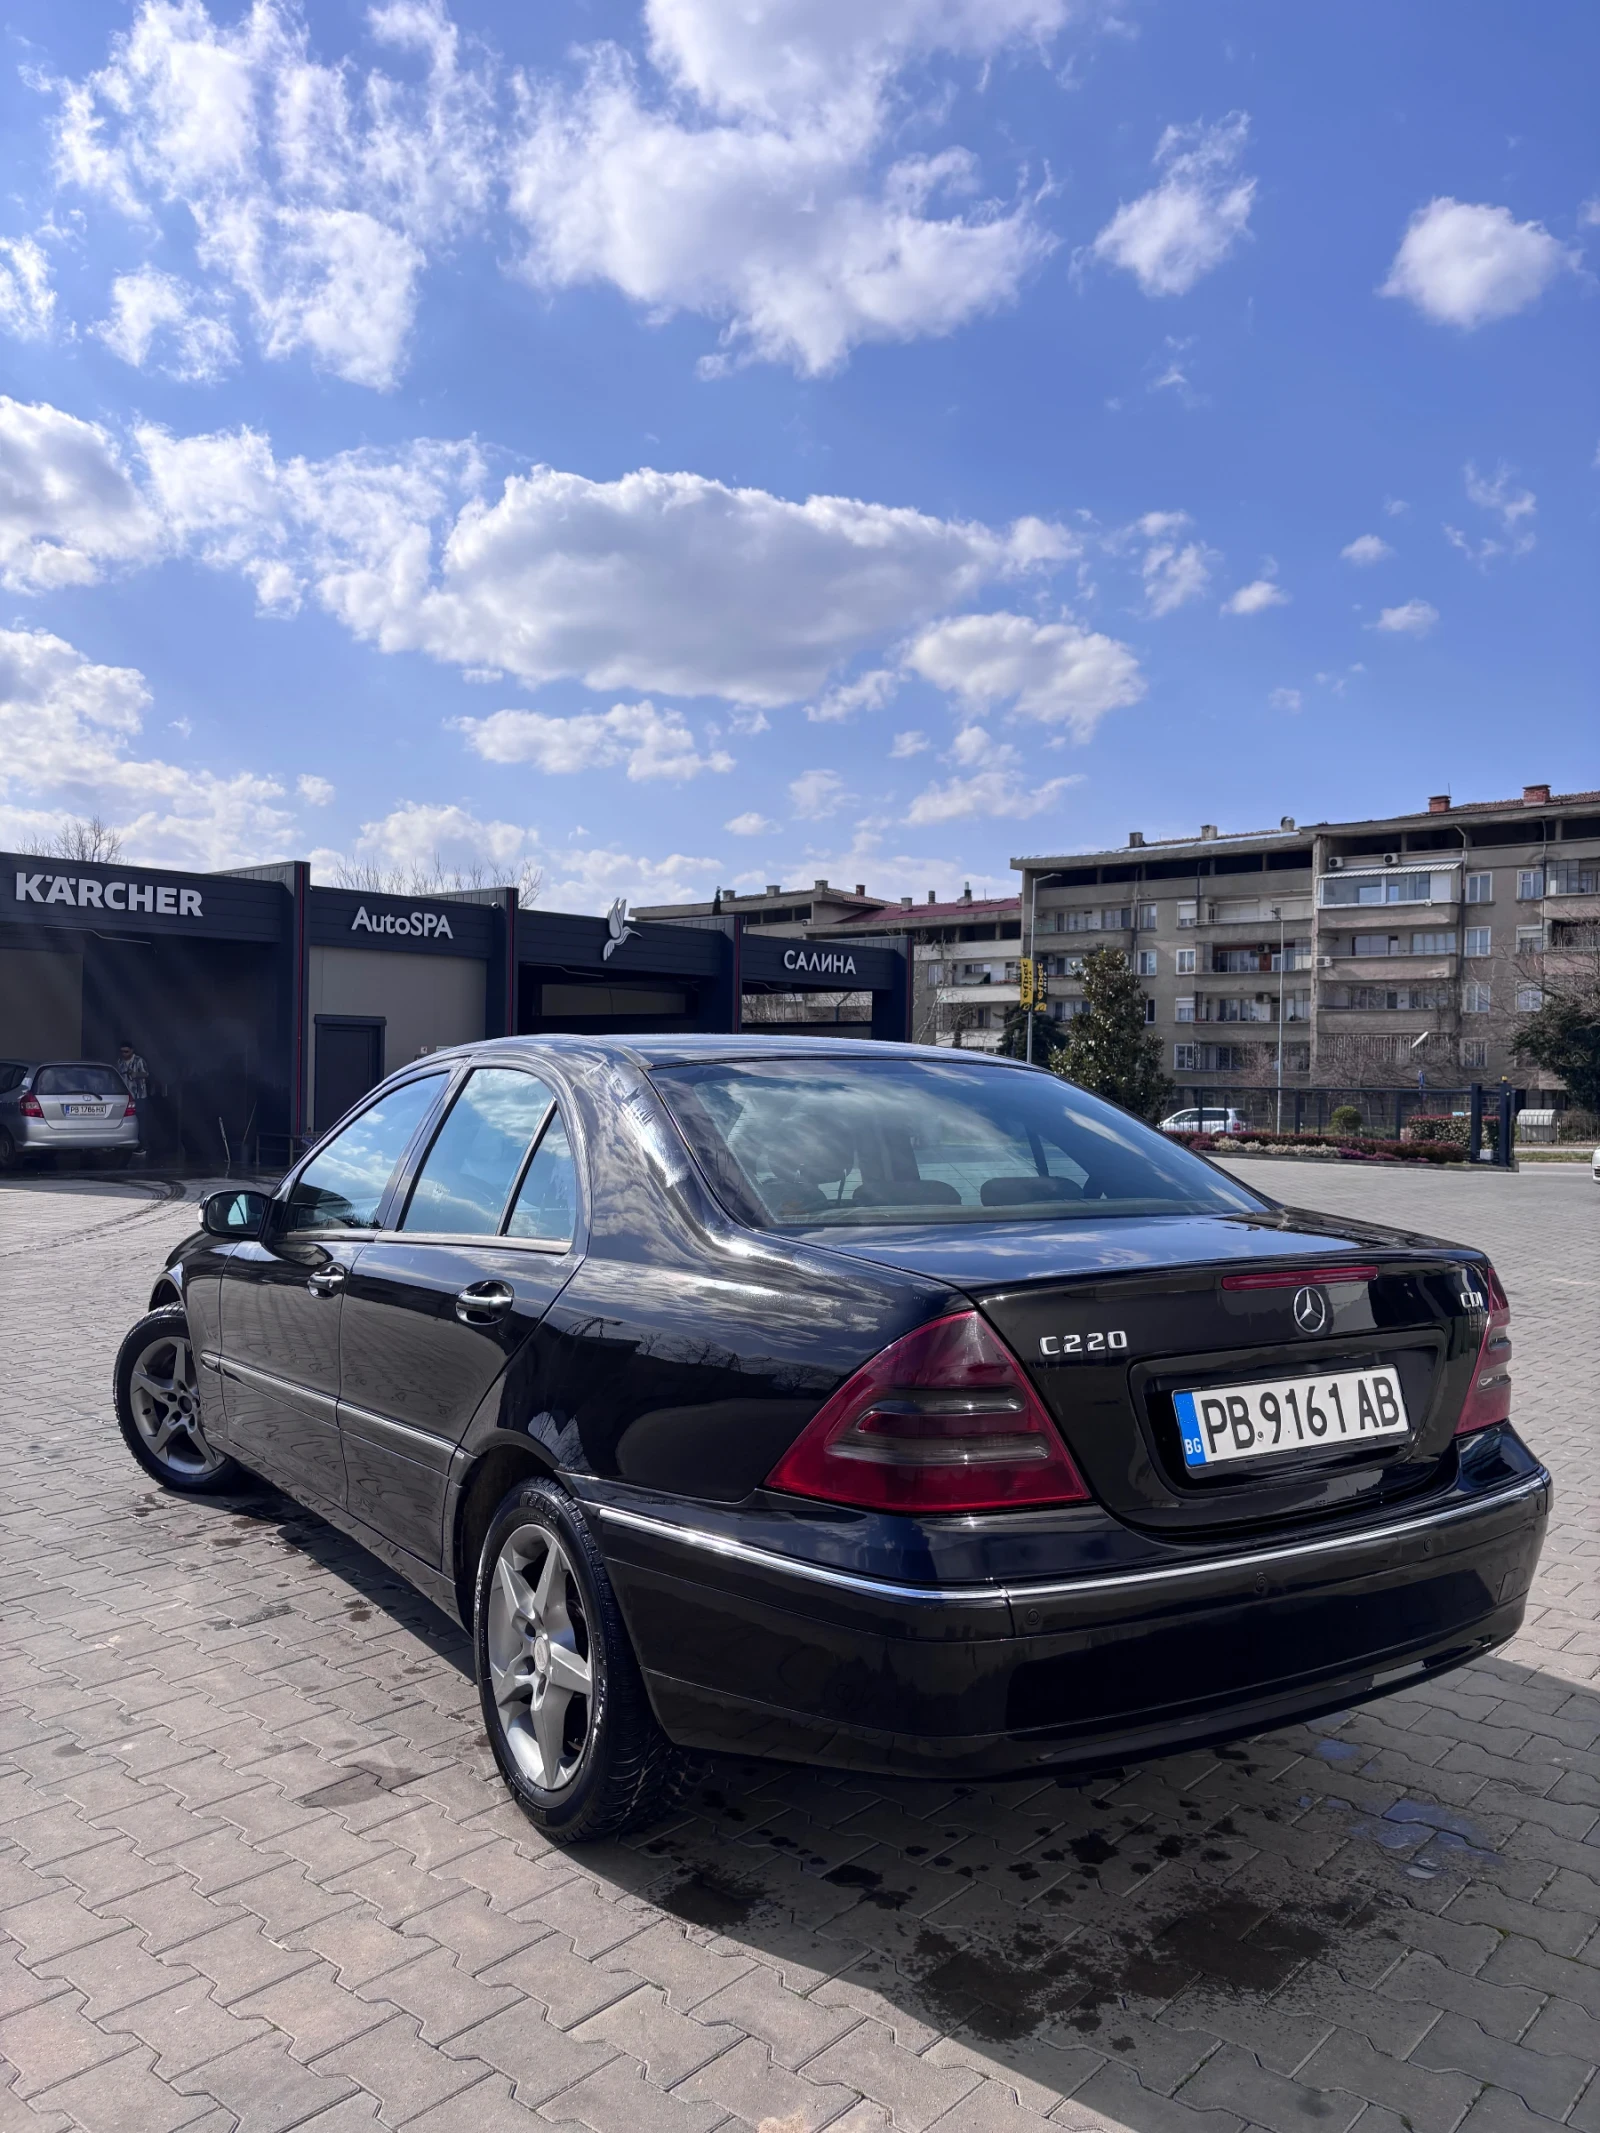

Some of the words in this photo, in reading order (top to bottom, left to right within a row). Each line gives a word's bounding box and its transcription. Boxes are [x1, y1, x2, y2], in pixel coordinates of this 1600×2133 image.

[15, 871, 204, 917] KÄRCHER
[351, 906, 454, 939] AutoSPA
[783, 949, 857, 975] САЛИНА
[1036, 962, 1044, 1000] efbet
[70, 1105, 79, 1113] PB
[1460, 1291, 1484, 1308] CDI
[1039, 1330, 1128, 1355] C220
[1200, 1395, 1255, 1454] PB
[1259, 1382, 1347, 1445] 9161
[1357, 1376, 1400, 1430] AB
[1184, 1438, 1202, 1456] BG
